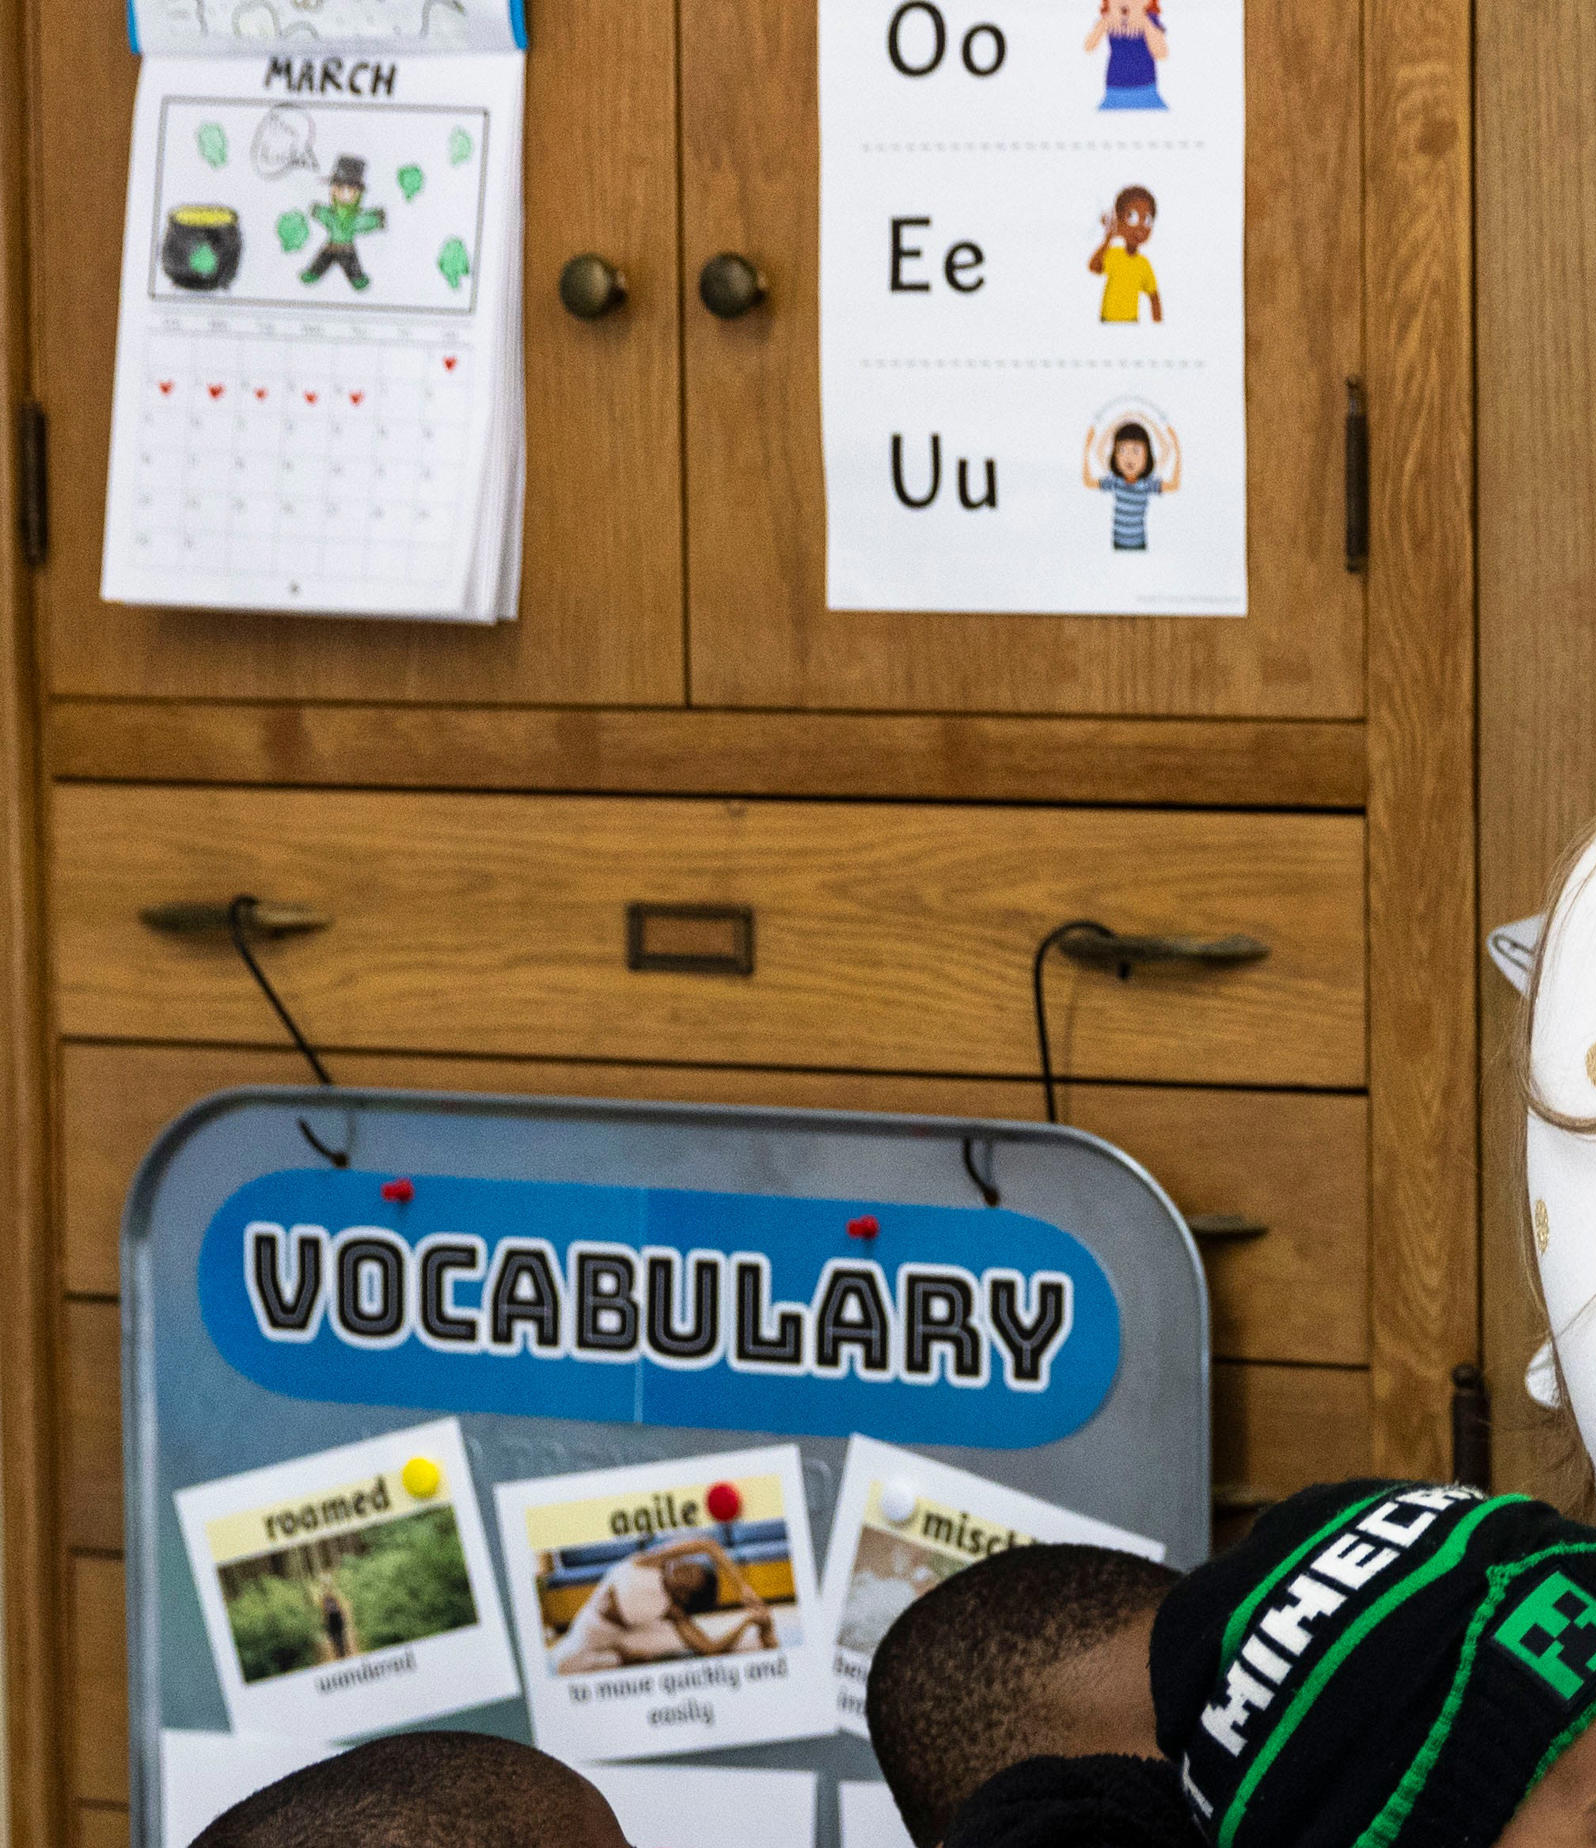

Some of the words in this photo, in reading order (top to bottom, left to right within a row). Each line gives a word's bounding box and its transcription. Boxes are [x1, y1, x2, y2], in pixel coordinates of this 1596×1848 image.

[886, 0, 1008, 78] Oo
[263, 56, 398, 97] MARCH
[889, 217, 986, 294] Ee
[891, 433, 998, 511] Uu
[247, 1223, 1072, 1389] VOCABULARY
[265, 1475, 391, 1541] roamed
[609, 1494, 700, 1538] agile
[568, 1683, 593, 1704] to
[595, 1675, 654, 1701] move
[658, 1664, 741, 1698] quickly
[743, 1655, 788, 1681] and
[648, 1699, 714, 1728] easily
